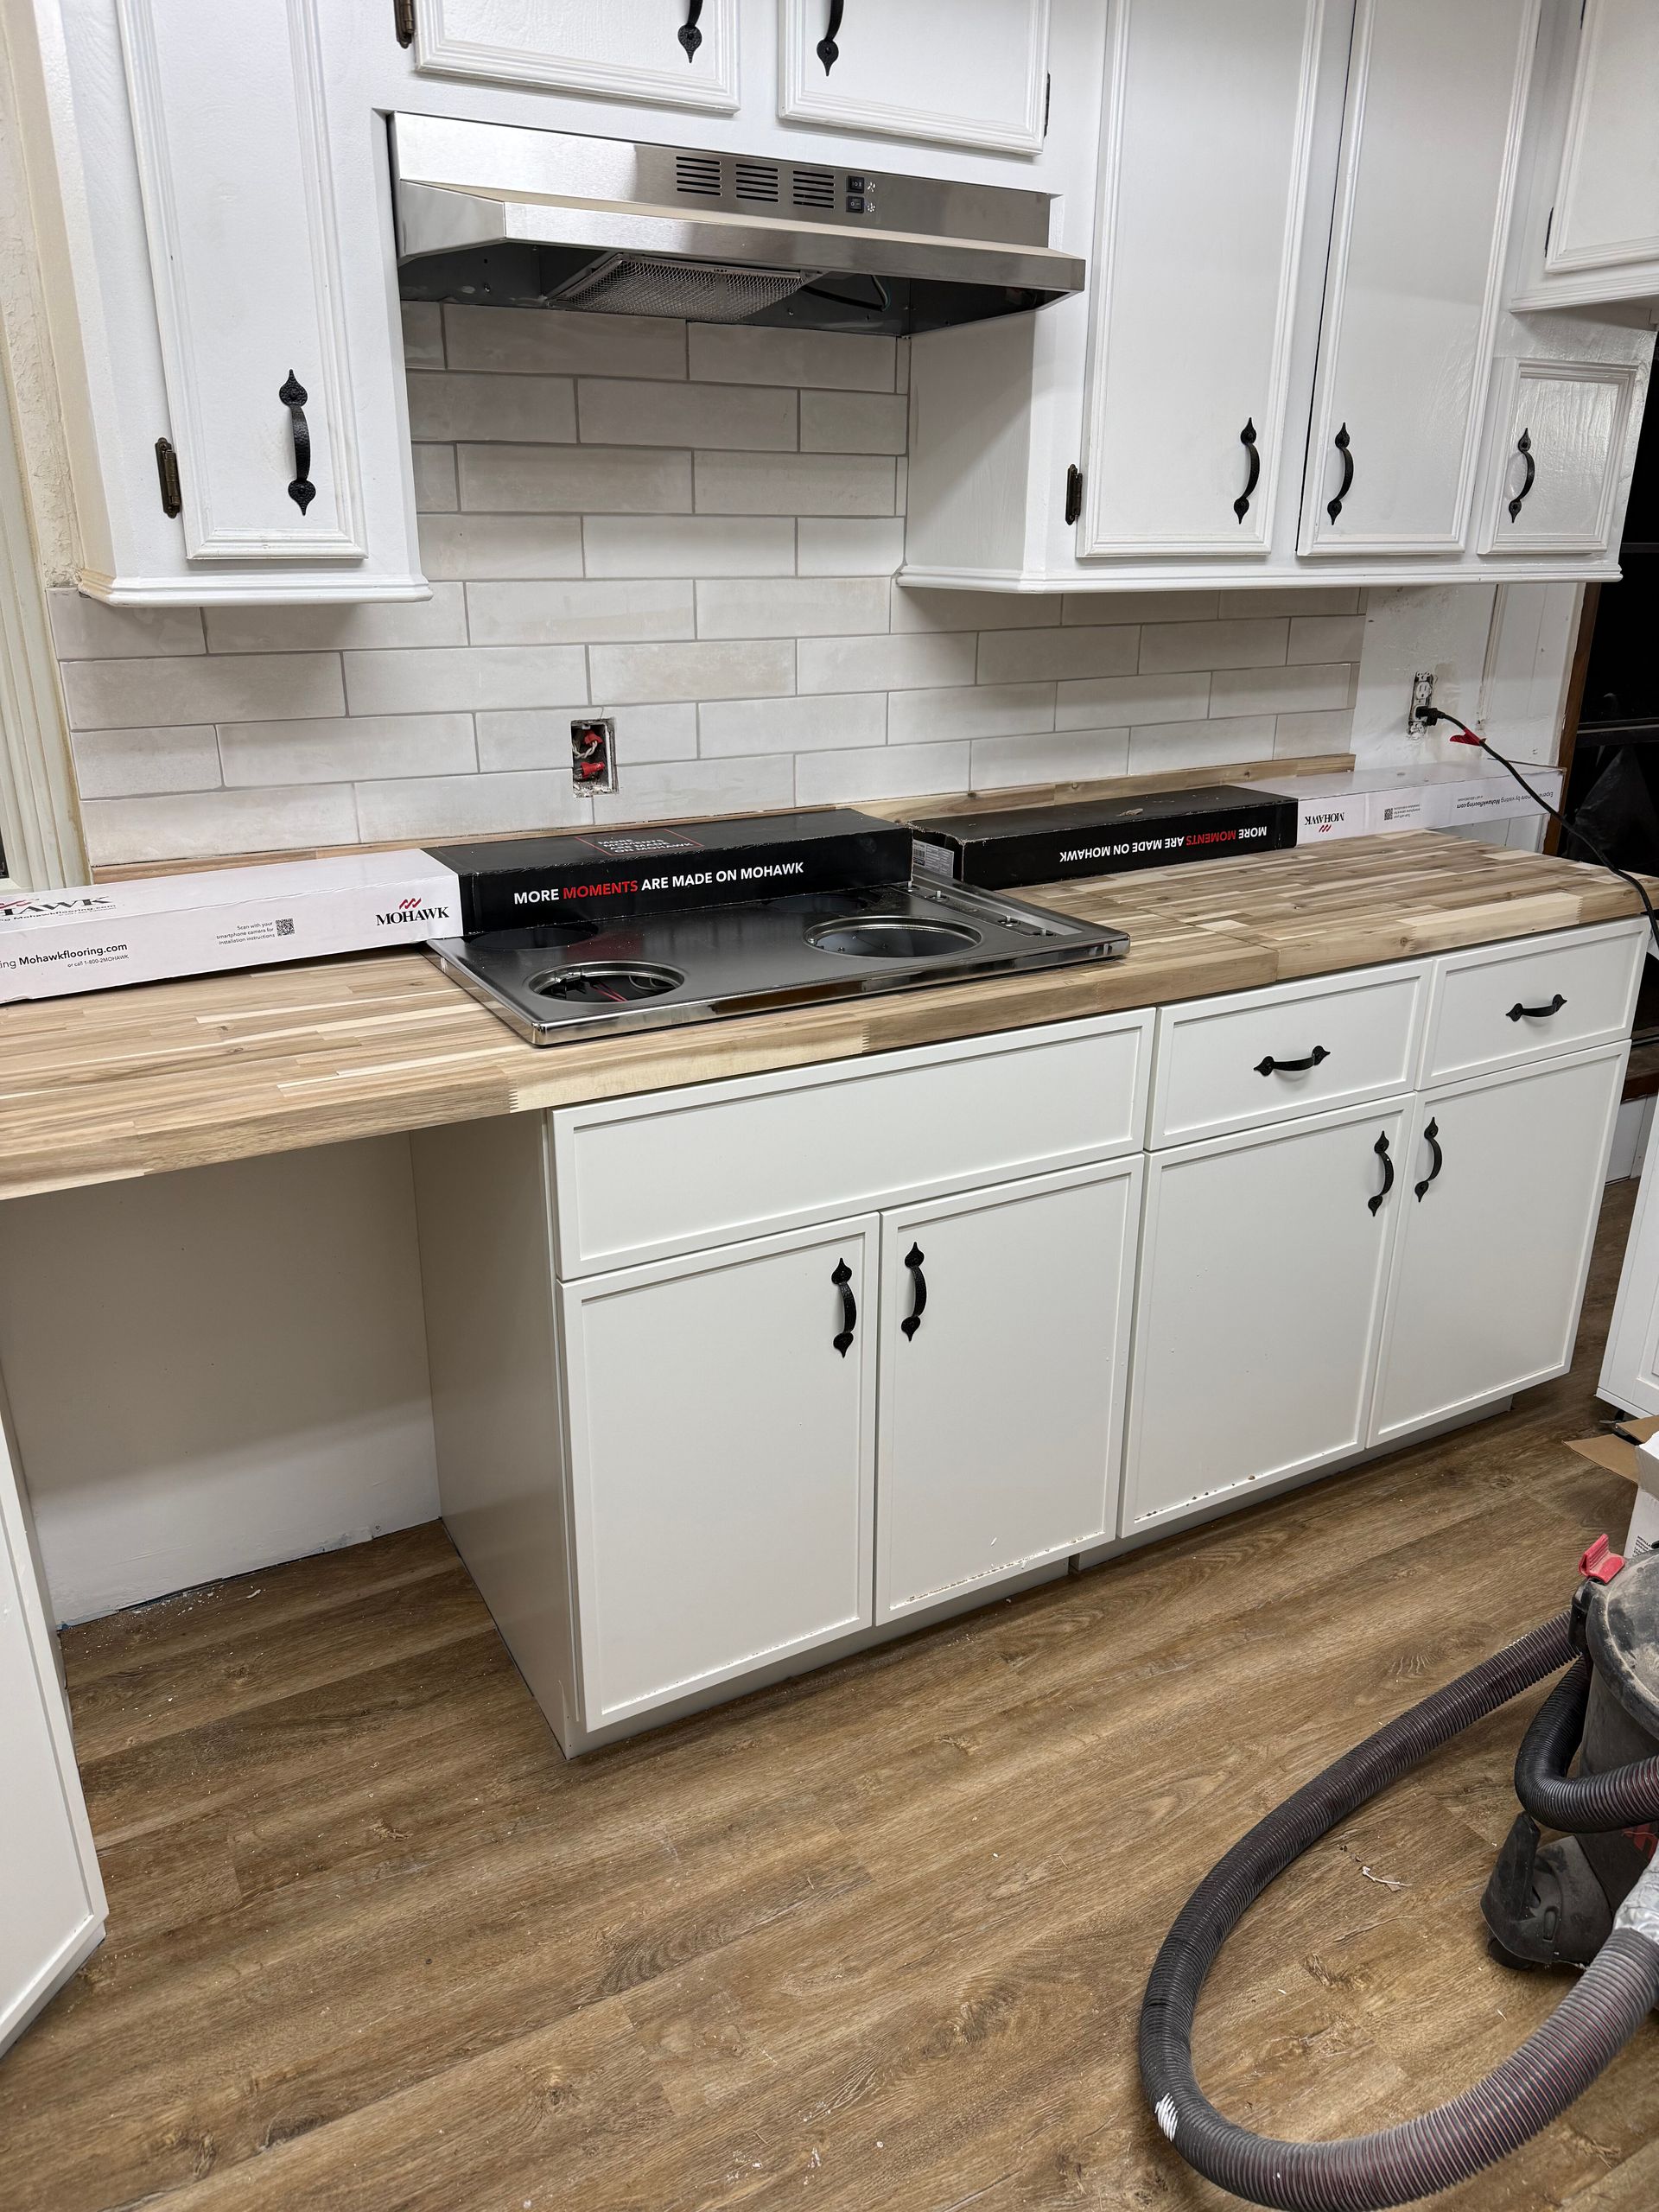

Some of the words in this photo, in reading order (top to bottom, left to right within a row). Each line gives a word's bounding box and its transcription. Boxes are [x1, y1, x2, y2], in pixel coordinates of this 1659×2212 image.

[1305, 812, 1344, 825] MOHAWK
[1186, 830, 1236, 846] MOMENTS
[1238, 826, 1267, 839] MORE
[1132, 839, 1162, 853] MADE
[1164, 836, 1185, 849] ARE
[1059, 846, 1110, 862] MOHAWK
[1113, 843, 1129, 856] ON
[513, 888, 560, 905] MORE
[563, 880, 639, 899] MOMENTS
[641, 876, 669, 891] ARE
[672, 872, 713, 887] MADE
[715, 868, 737, 882] ON
[741, 861, 804, 880] MOHAWK
[376, 906, 449, 926] MOHAWK
[216, 931, 247, 940] smartphone
[18, 944, 128, 966] Mohawkflooring.com
[85, 954, 130, 965] 1-800-2MOHAWK
